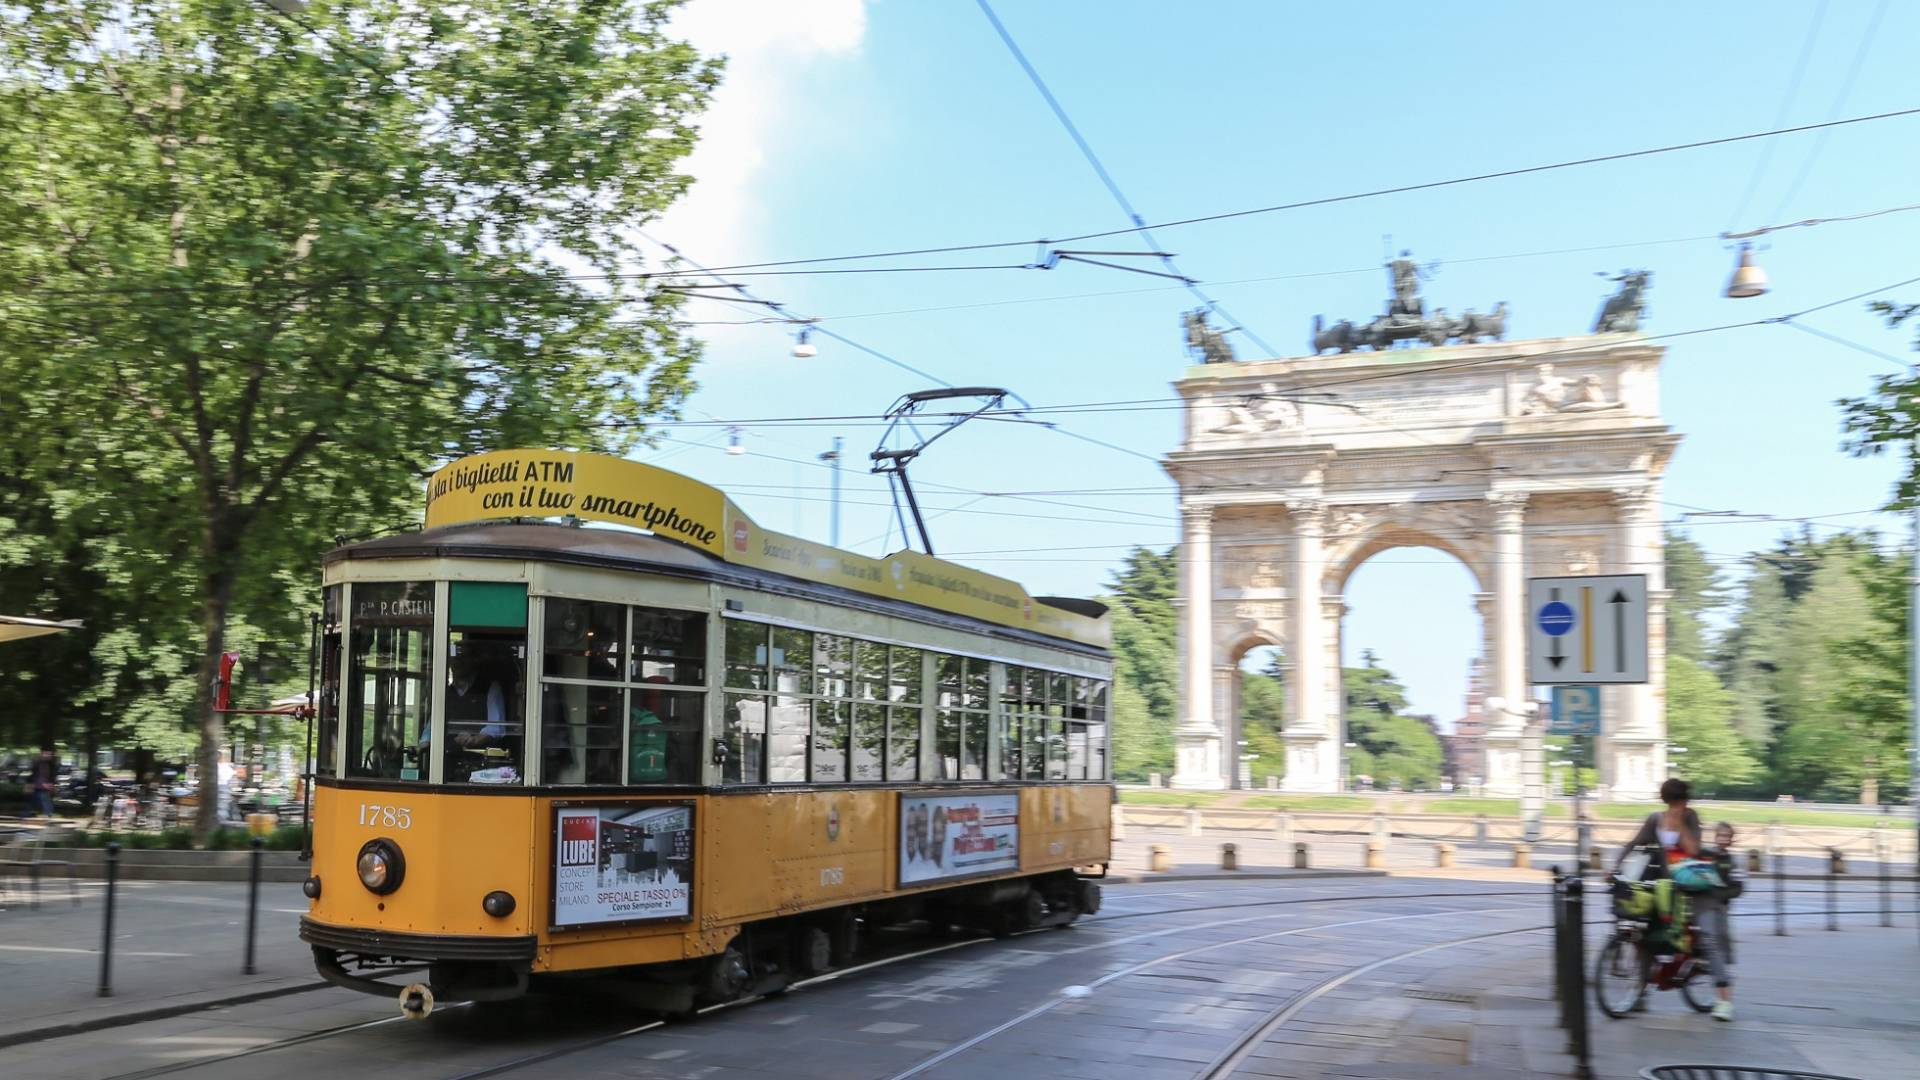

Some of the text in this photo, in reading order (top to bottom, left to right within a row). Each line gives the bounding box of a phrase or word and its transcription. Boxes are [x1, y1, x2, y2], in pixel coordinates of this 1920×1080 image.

[455, 459, 518, 493] biglietti
[524, 461, 573, 483] ATM
[482, 487, 514, 509] con
[519, 485, 533, 508] il
[538, 487, 576, 509] tuo
[580, 492, 717, 545] smartphone
[359, 803, 412, 829] 1785
[563, 840, 595, 864] LUBE
[560, 868, 595, 879] CONCEPT
[560, 882, 585, 893] STORE
[559, 894, 590, 906] MILANO
[597, 890, 640, 904] SPECIALE
[641, 888, 671, 901] TASSO
[612, 903, 631, 912] Corso
[632, 901, 662, 911] Sempione
